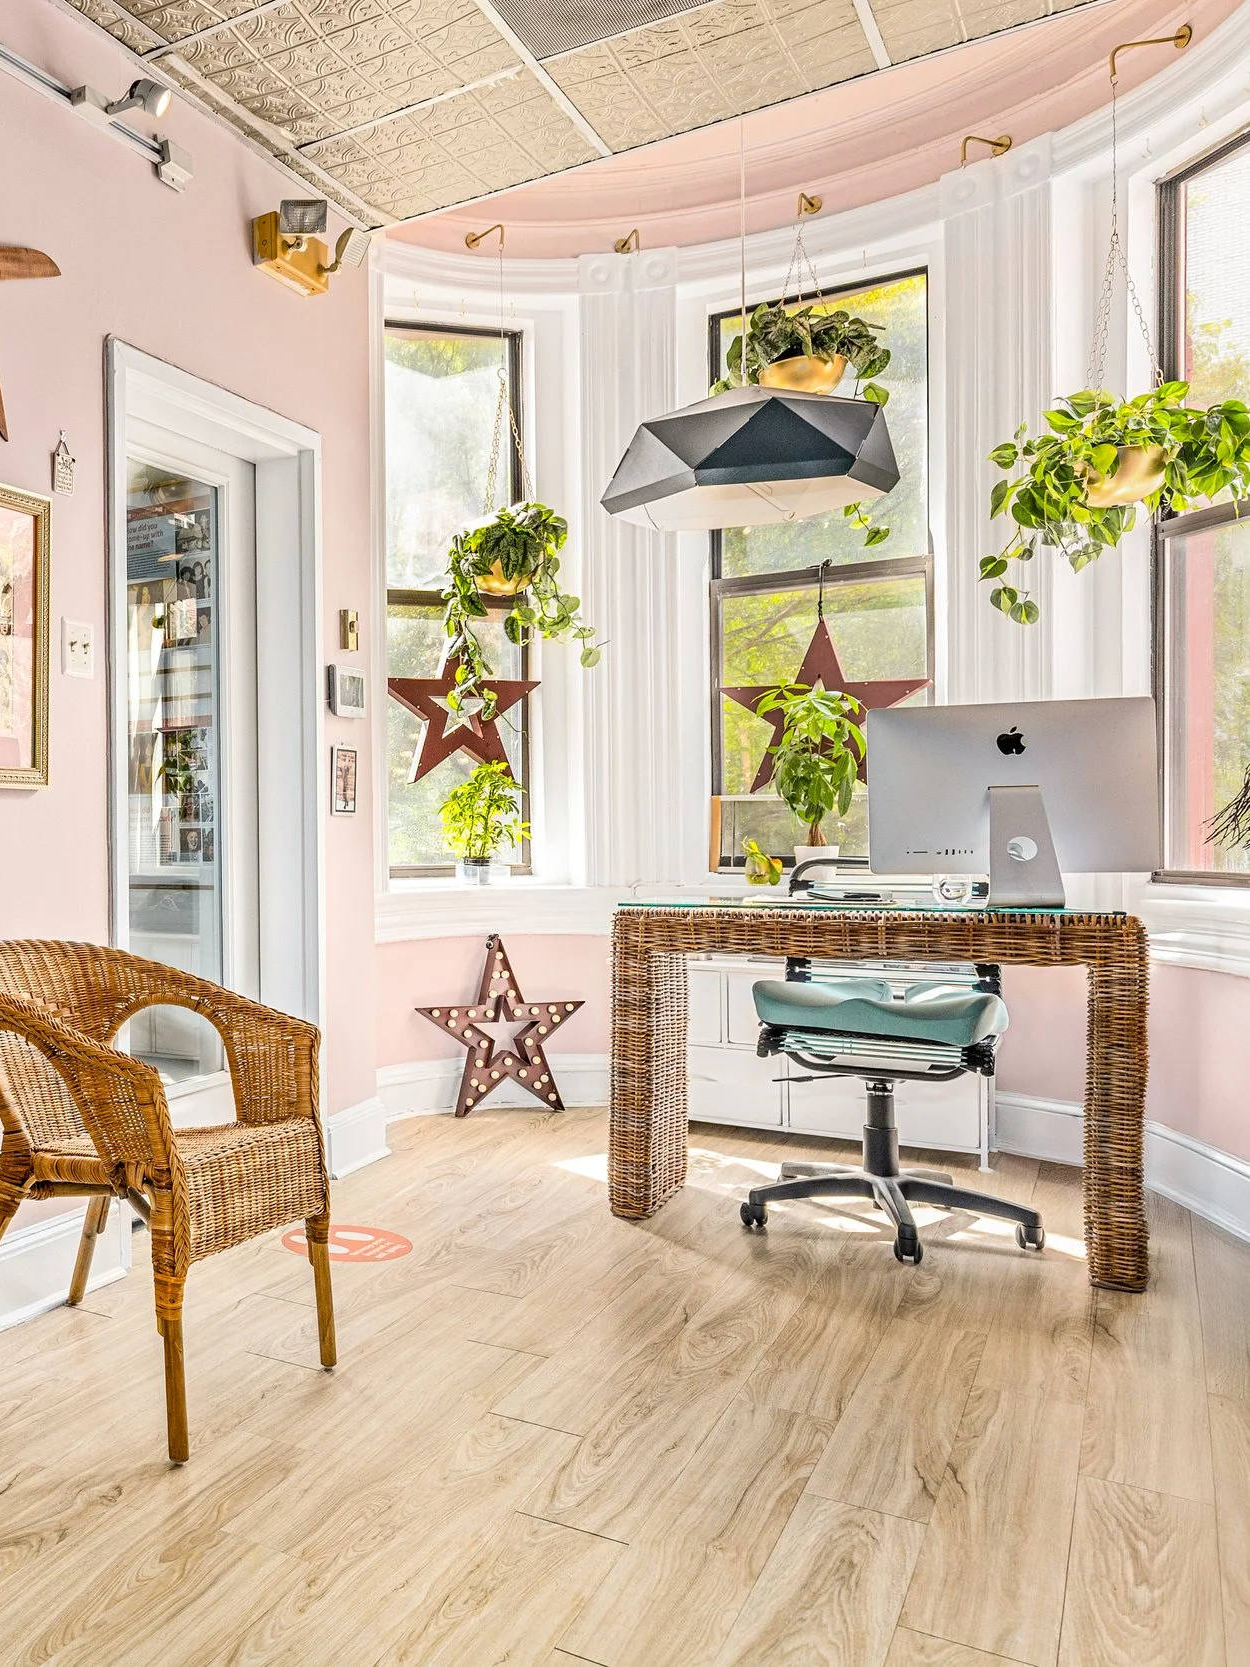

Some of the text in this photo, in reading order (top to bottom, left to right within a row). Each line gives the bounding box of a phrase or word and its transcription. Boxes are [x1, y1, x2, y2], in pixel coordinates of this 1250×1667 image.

[137, 523, 147, 532] did
[147, 523, 158, 532] you
[150, 529, 164, 538] with
[135, 540, 154, 550] name?
